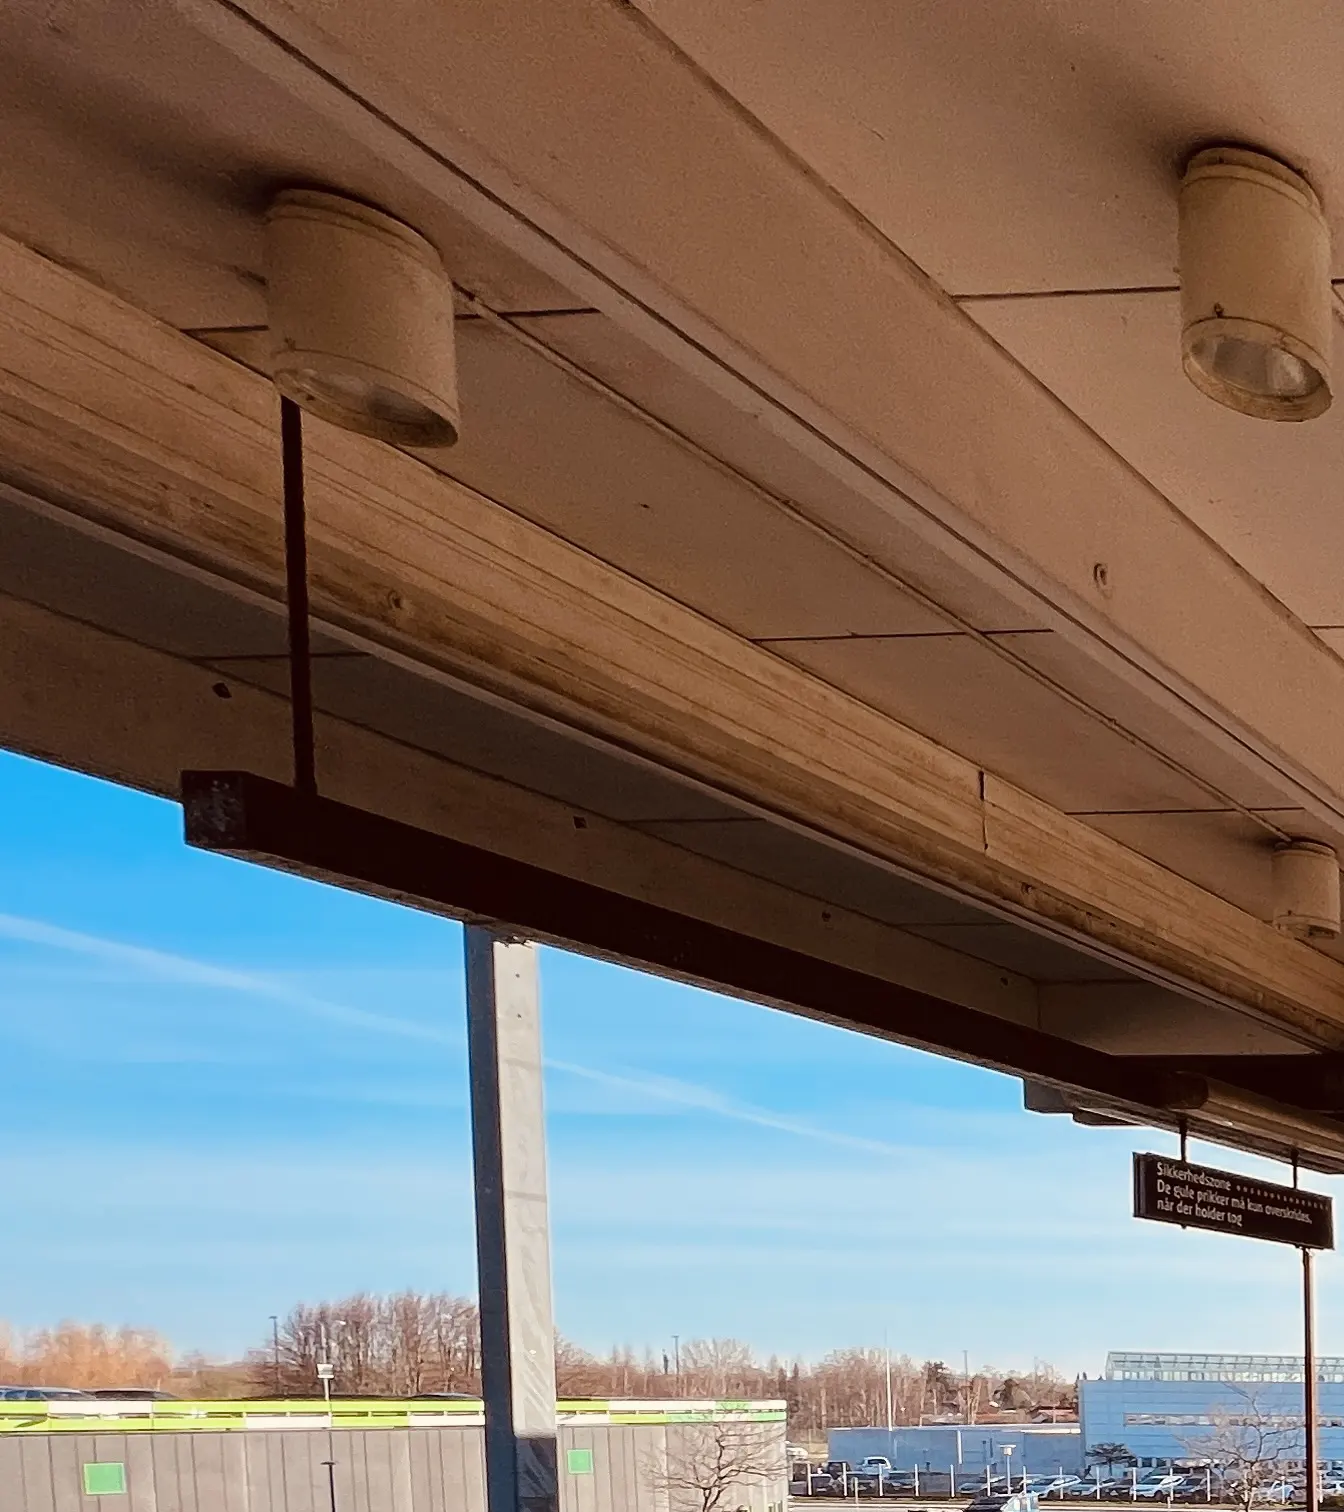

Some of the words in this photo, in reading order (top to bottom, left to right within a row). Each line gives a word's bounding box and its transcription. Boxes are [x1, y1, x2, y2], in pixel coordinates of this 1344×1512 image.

[1156, 1162, 1231, 1190] Sikkerhedszone
[1157, 1180, 1171, 1195] De
[1174, 1185, 1194, 1199] gule
[1197, 1191, 1229, 1206] prikker
[1231, 1196, 1245, 1209] må
[1247, 1200, 1263, 1213] kun
[1157, 1198, 1174, 1211] når
[1177, 1202, 1193, 1215] der
[1195, 1205, 1225, 1221] holder
[1227, 1213, 1243, 1226] tog
